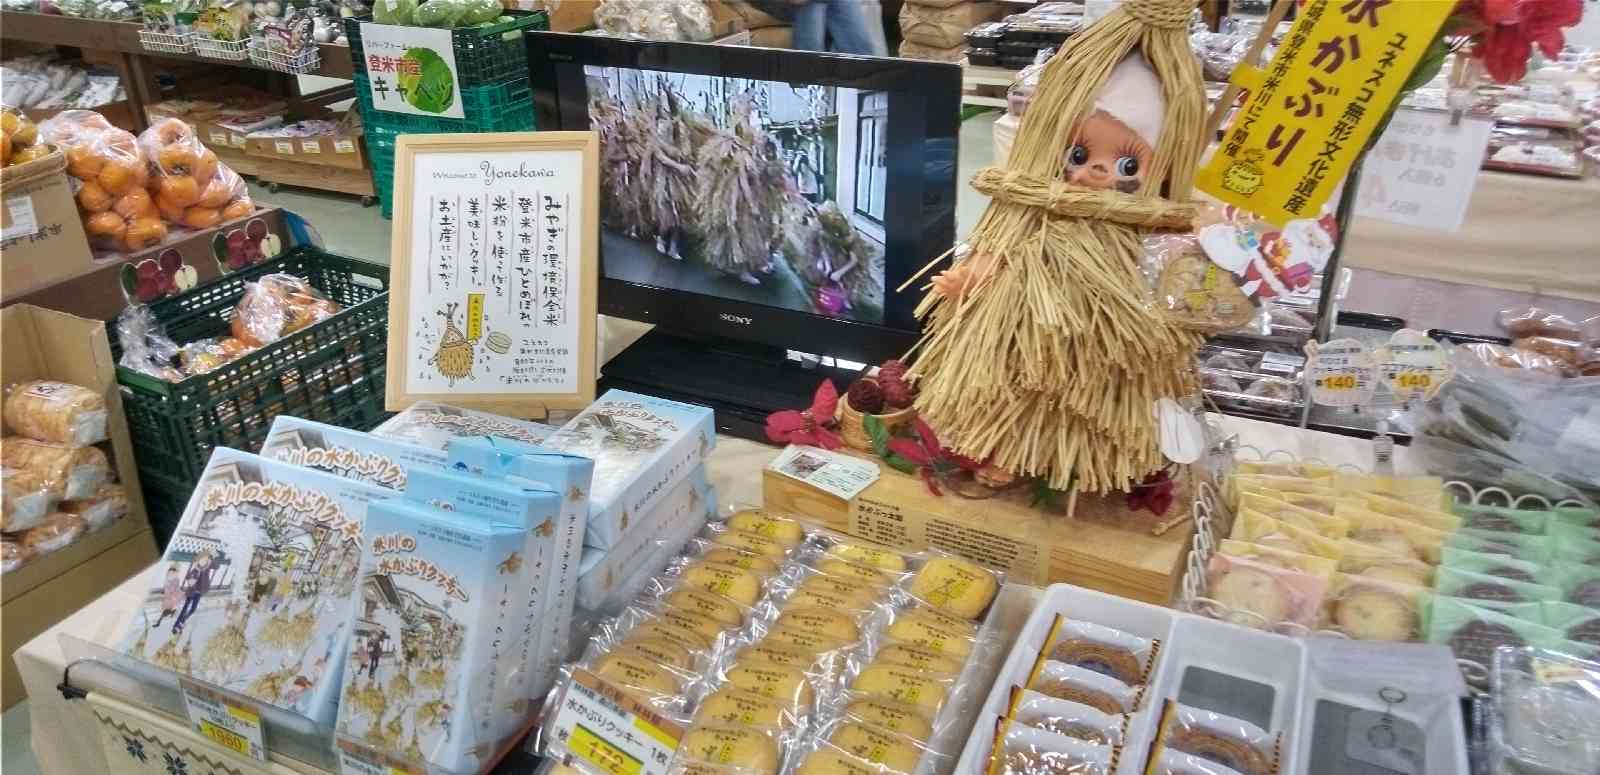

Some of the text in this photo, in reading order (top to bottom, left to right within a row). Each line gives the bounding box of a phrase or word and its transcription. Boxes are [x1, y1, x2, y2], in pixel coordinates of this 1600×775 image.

[368, 54, 421, 76] 登米市産
[374, 76, 454, 106] キャベツ
[1283, 33, 1408, 215] ユネスコ無形文化遺産
[480, 160, 556, 186] Yonekawa
[542, 195, 562, 328] みやぎの環境保全米
[720, 313, 753, 325] SONY
[1325, 375, 1354, 388] 140
[1401, 373, 1430, 388] 140
[566, 697, 643, 747] 水かぶりクッキー
